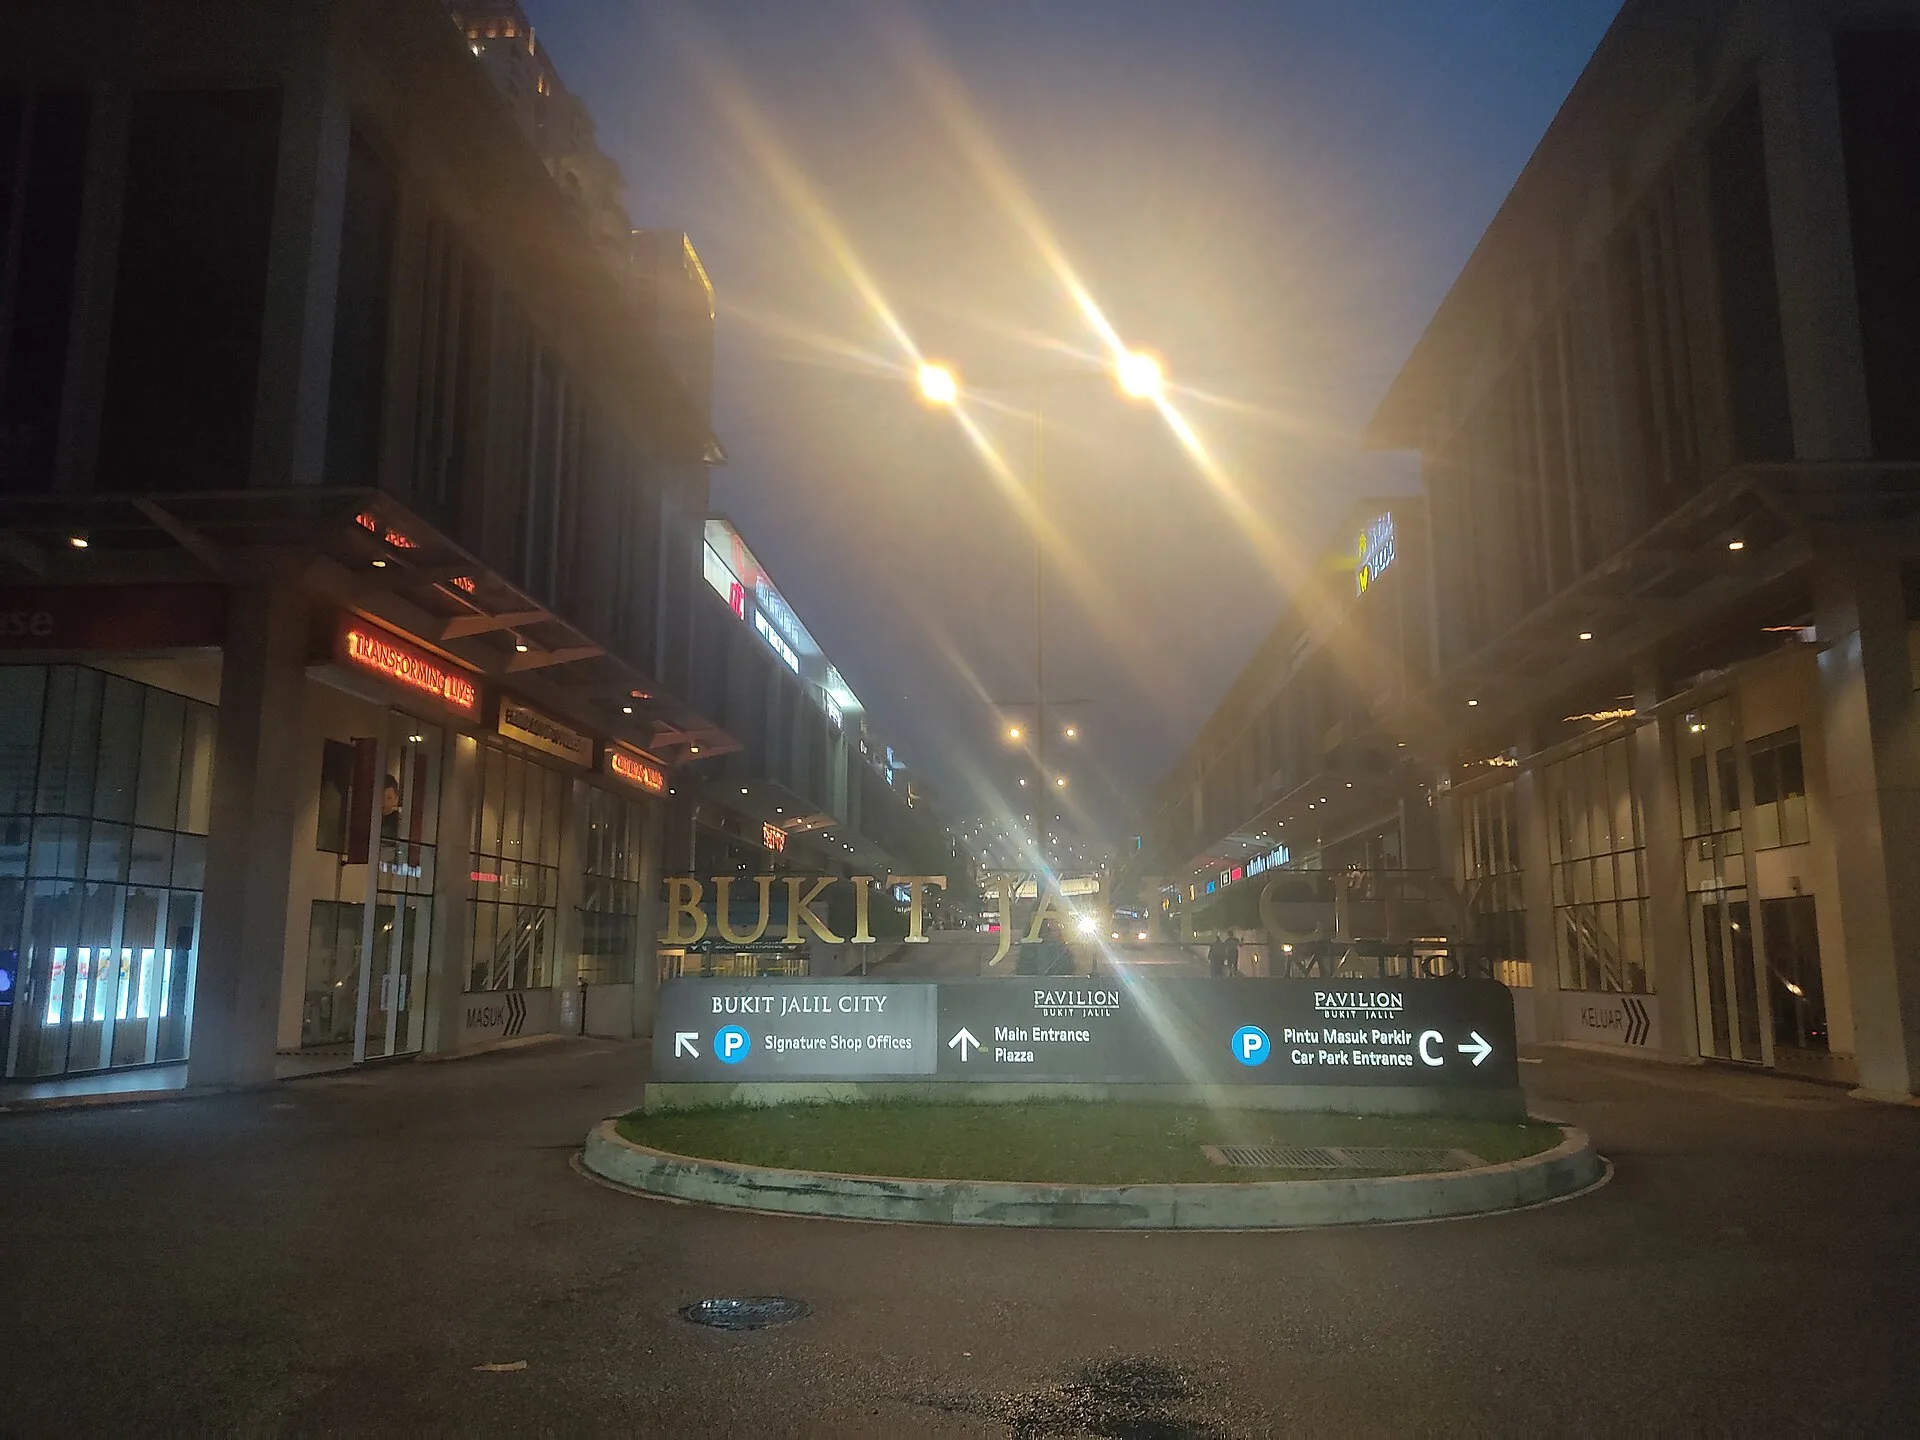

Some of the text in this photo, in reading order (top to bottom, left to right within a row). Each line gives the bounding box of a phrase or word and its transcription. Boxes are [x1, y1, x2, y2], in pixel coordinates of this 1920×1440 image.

[657, 875, 947, 945] BUKIT
[711, 995, 888, 1017] BUKIT JALIL CITY
[1033, 990, 1120, 1005] PAVILION
[1314, 991, 1404, 1007] PAVILION
[467, 1006, 505, 1029] MASUK
[1043, 1008, 1112, 1018] BUKIT JALIL
[1324, 1010, 1396, 1020] BUKIT JALIL
[1581, 1006, 1624, 1031] KELUAR
[994, 1026, 1090, 1042] Main Entrance
[1283, 1028, 1412, 1045] Pintu Masuk Parkir
[764, 1034, 912, 1053] Signature Shop Offices
[1418, 1030, 1444, 1067] C
[994, 1047, 1034, 1063] Plazza
[1291, 1049, 1413, 1066] Car Park Entrance
